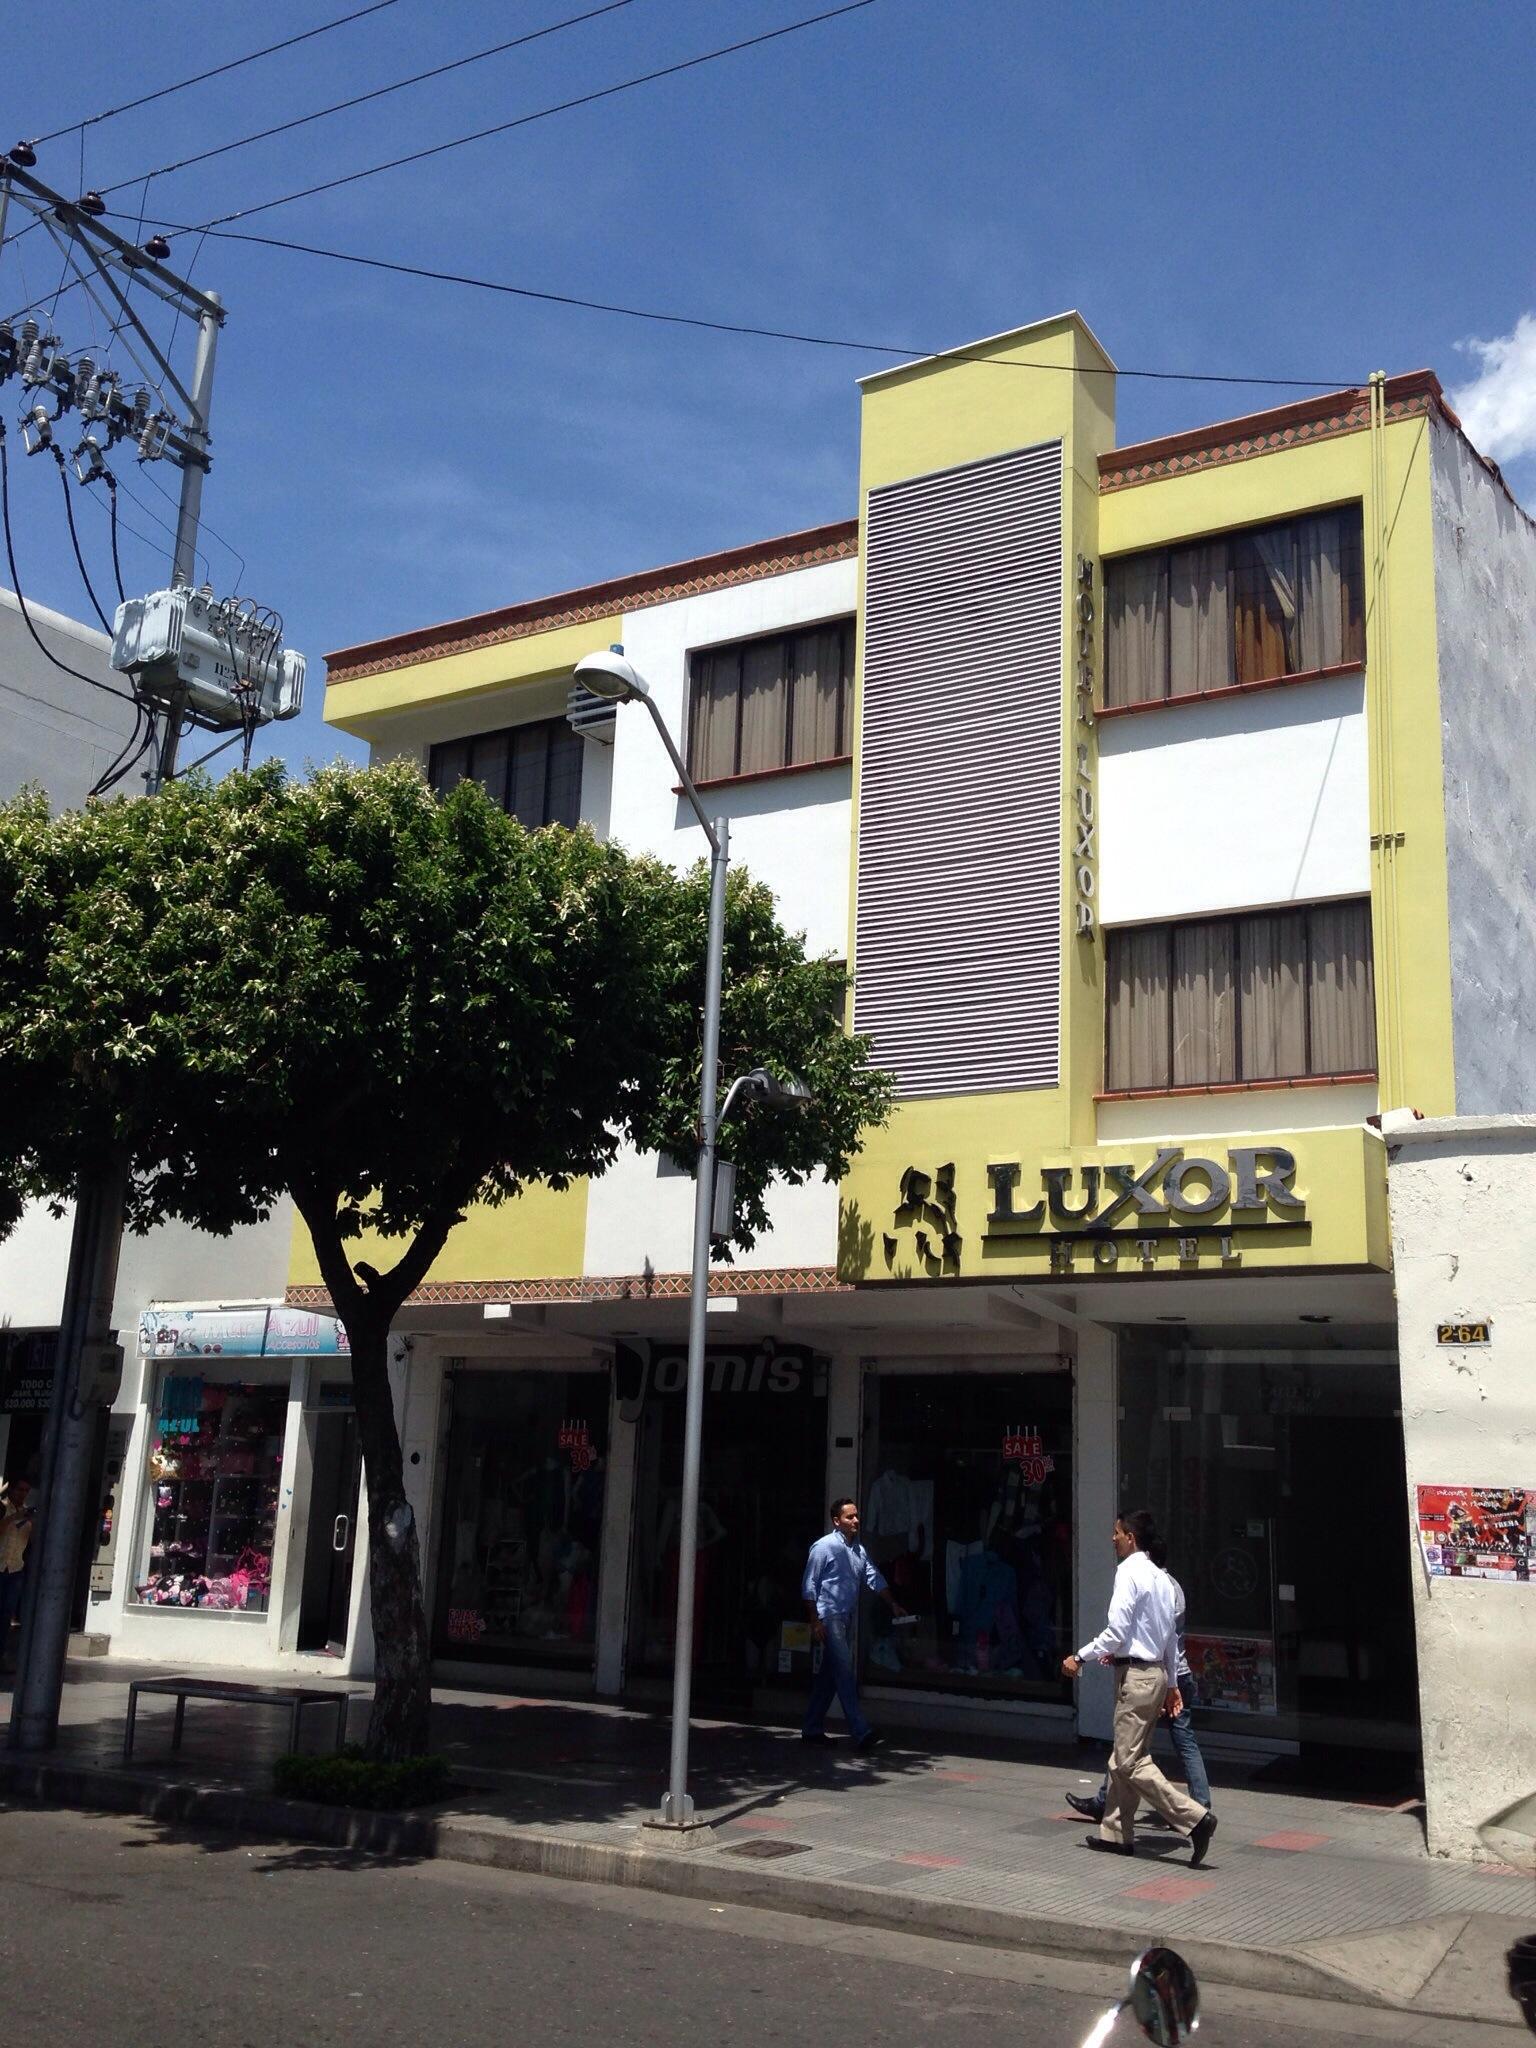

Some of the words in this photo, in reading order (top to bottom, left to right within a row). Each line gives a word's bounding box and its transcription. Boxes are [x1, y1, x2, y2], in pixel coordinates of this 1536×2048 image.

[1076, 552, 1095, 728] HOTEL
[1072, 743, 1096, 943] LUXOR
[986, 1146, 1307, 1230] LUXOR
[1049, 1236, 1243, 1267] HOTEL
[268, 1312, 320, 1338] Azul
[1441, 1325, 1486, 1343] 2-64
[560, 1433, 587, 1447] SALE
[1005, 1442, 1041, 1457] SALE
